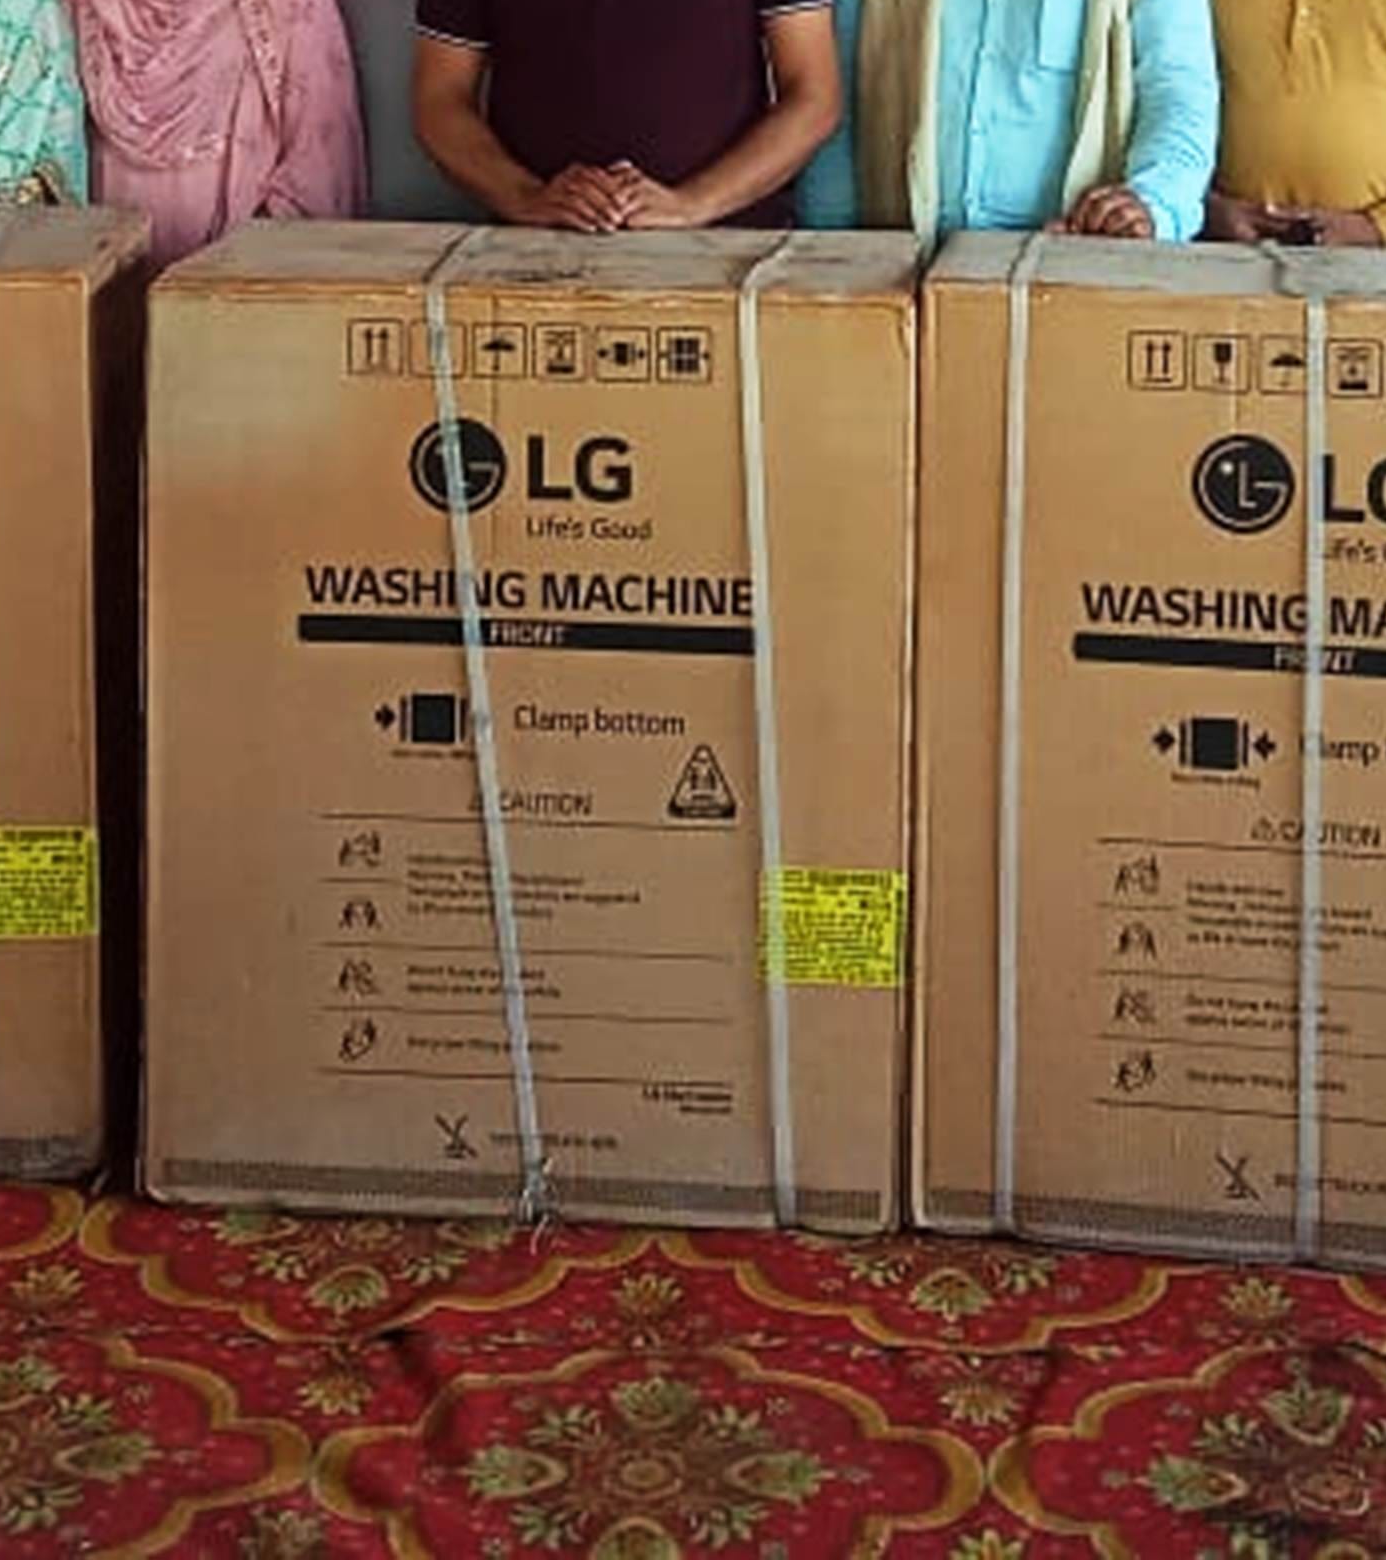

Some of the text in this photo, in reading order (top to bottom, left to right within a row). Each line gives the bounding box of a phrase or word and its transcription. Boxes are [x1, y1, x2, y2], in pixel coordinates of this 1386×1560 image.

[526, 434, 633, 503] LG
[526, 515, 654, 542] Life's Good
[305, 565, 755, 618] WASHING MACHINE
[1080, 582, 1309, 632] WASHING
[489, 621, 567, 645] FRONT
[1273, 646, 1357, 674] FRNT
[513, 704, 686, 737] Clamp bottom
